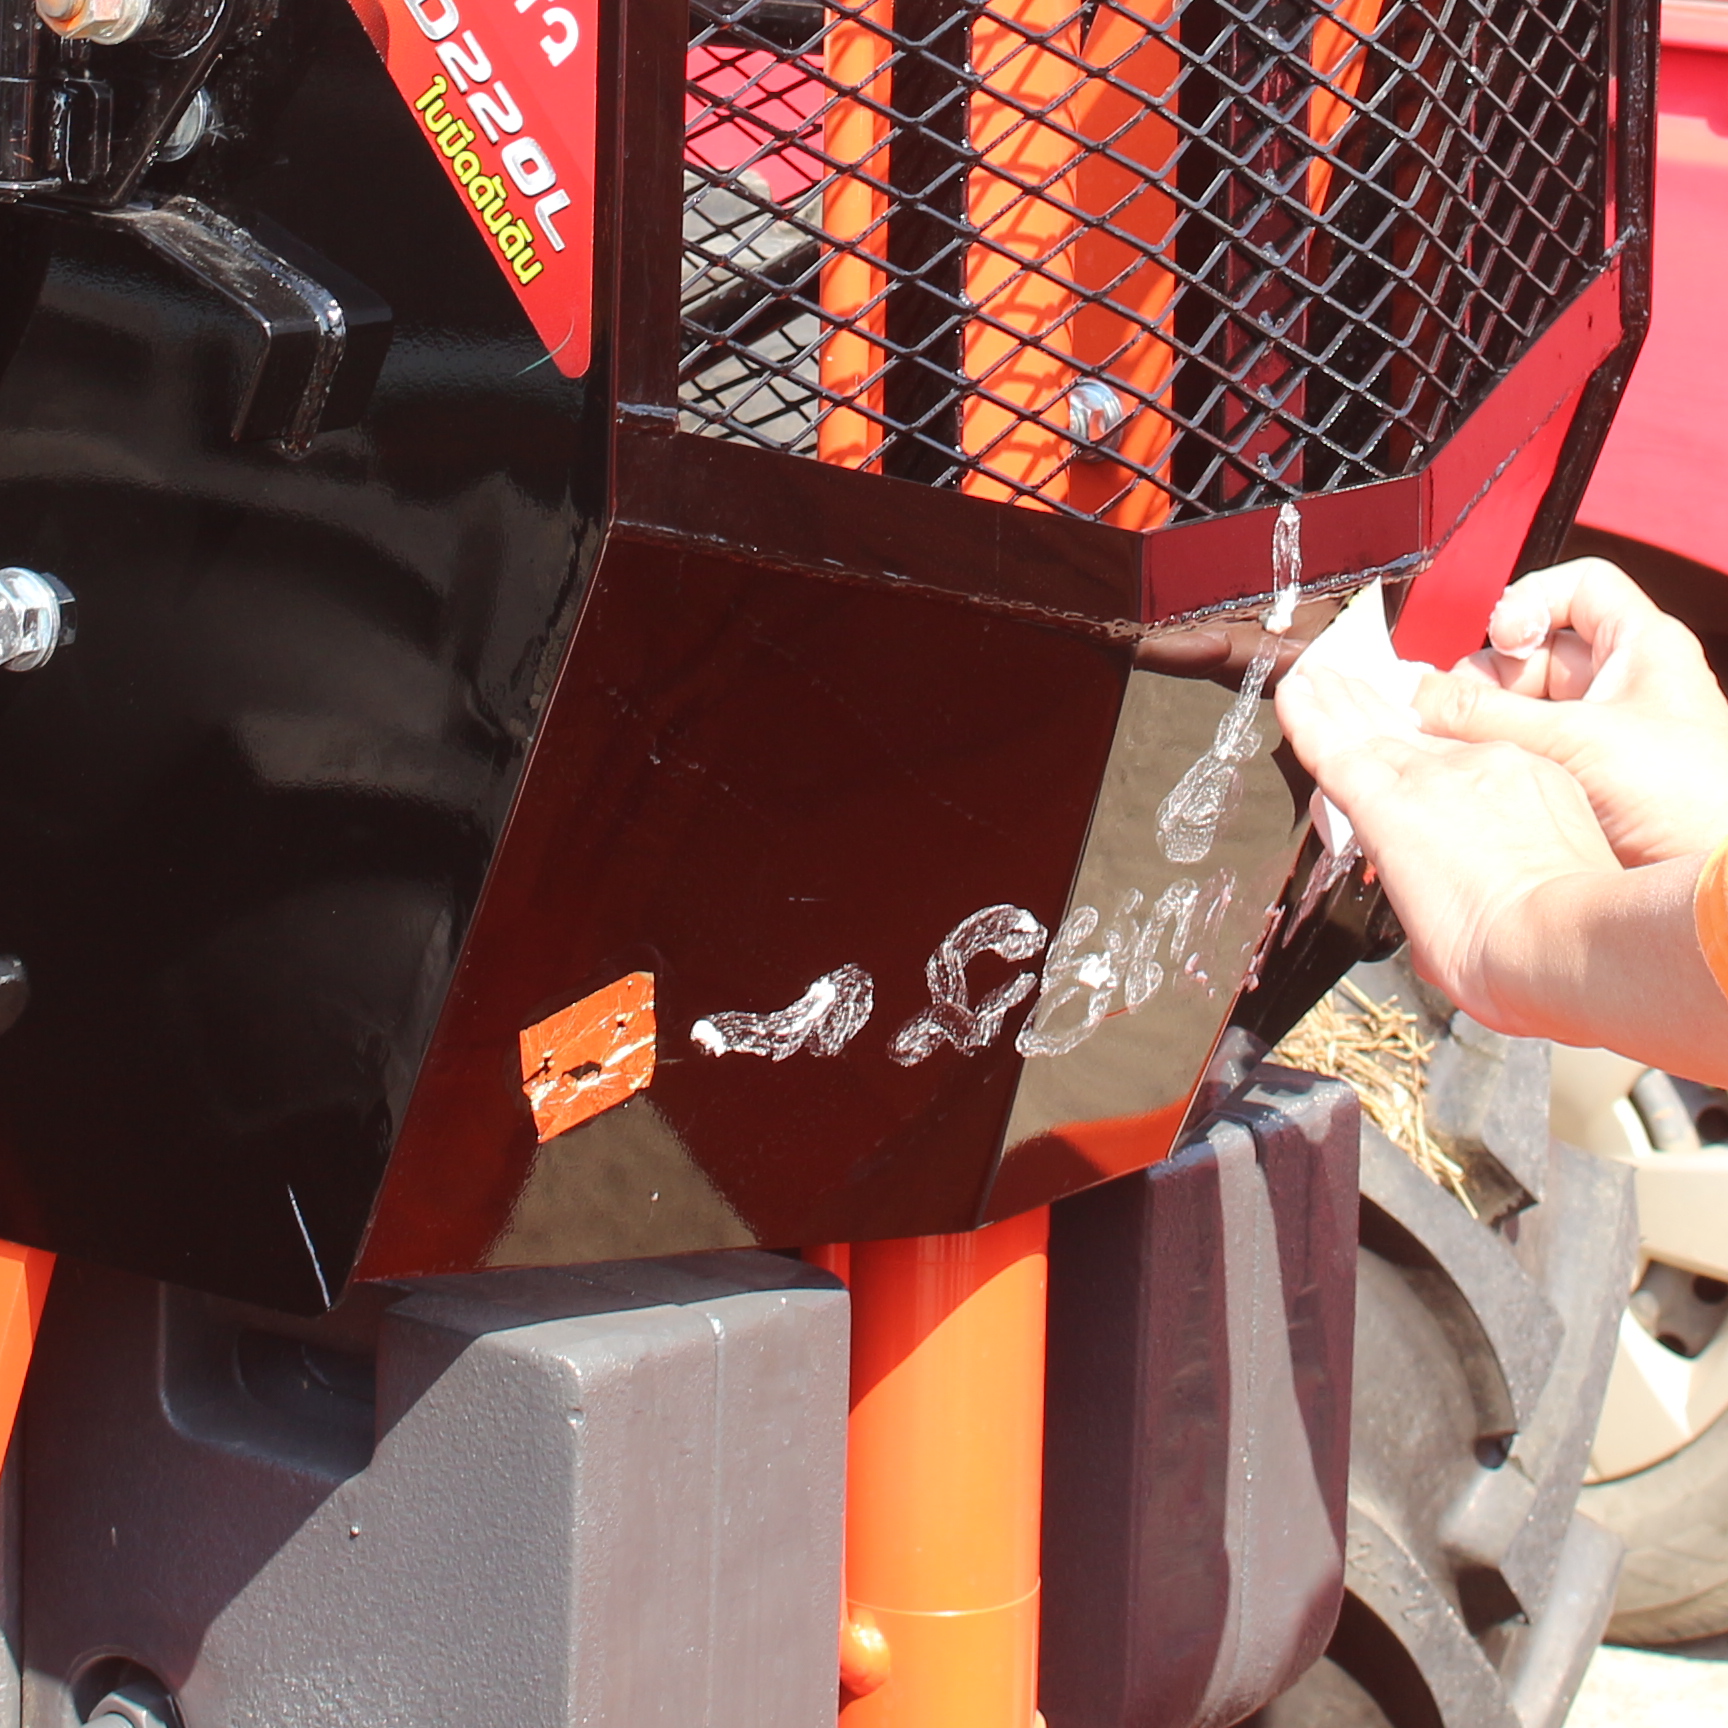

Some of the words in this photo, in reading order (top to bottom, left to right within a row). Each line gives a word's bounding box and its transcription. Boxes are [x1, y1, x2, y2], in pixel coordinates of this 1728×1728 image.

[414, 74, 544, 286] ใบมีดดันดิน
